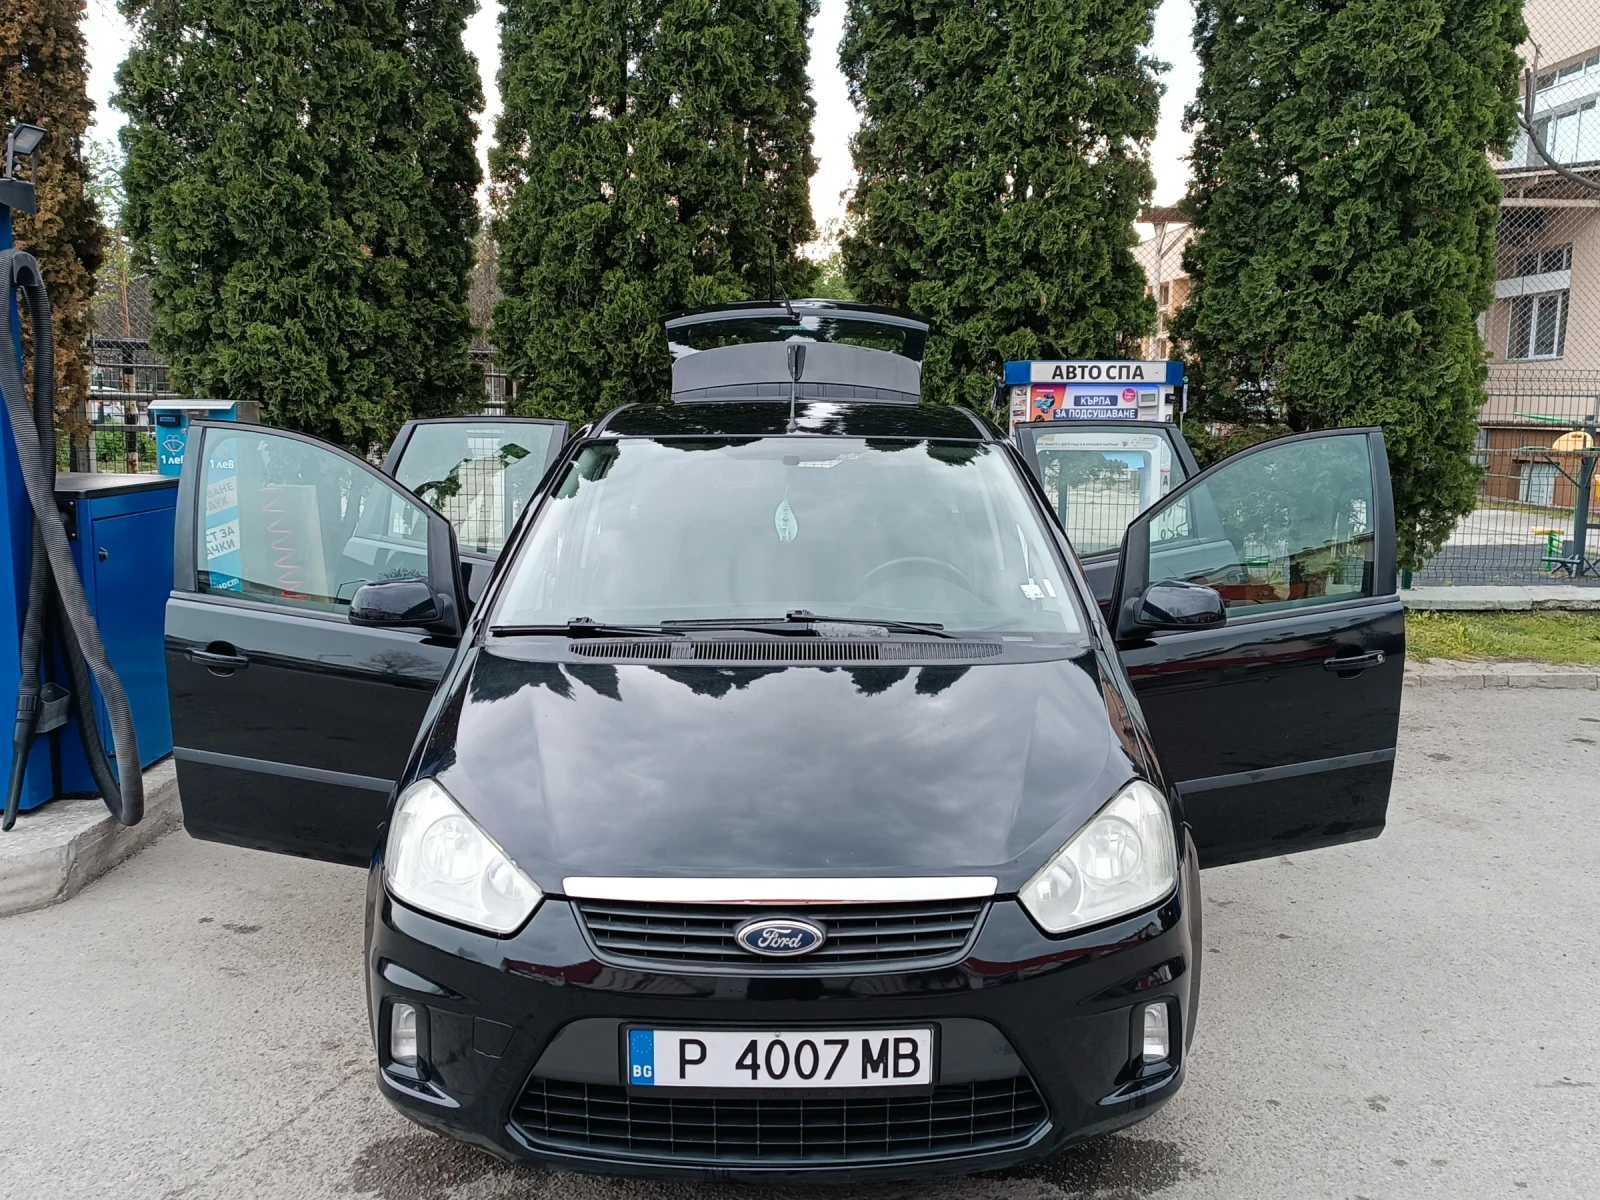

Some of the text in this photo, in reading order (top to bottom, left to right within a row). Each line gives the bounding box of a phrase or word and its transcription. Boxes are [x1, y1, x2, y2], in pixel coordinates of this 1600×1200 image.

[1052, 365, 1144, 380] АВТО СПА
[1080, 397, 1111, 406] КЪРПА
[1055, 409, 1136, 419] ЗА ПОДСУШАВАНЕ
[161, 455, 167, 464] 1
[209, 459, 215, 469] 1
[219, 526, 235, 539] ЗА
[758, 928, 803, 948] Ford
[632, 1065, 653, 1077] BG
